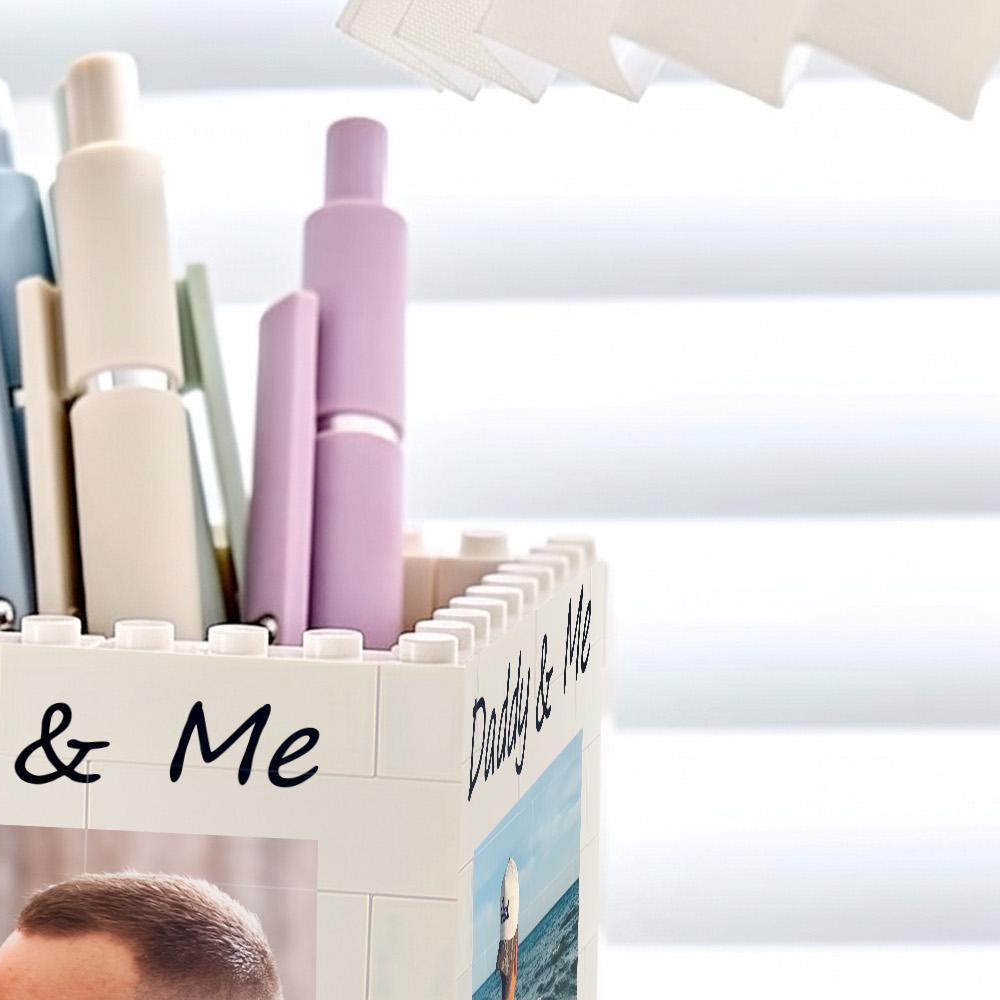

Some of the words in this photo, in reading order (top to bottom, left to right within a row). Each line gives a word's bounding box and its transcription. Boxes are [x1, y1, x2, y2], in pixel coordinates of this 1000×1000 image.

[14, 702, 111, 785] &
[169, 700, 320, 788] Me
[467, 650, 531, 802] Daddy
[535, 633, 554, 733] &
[563, 584, 592, 695] Me
